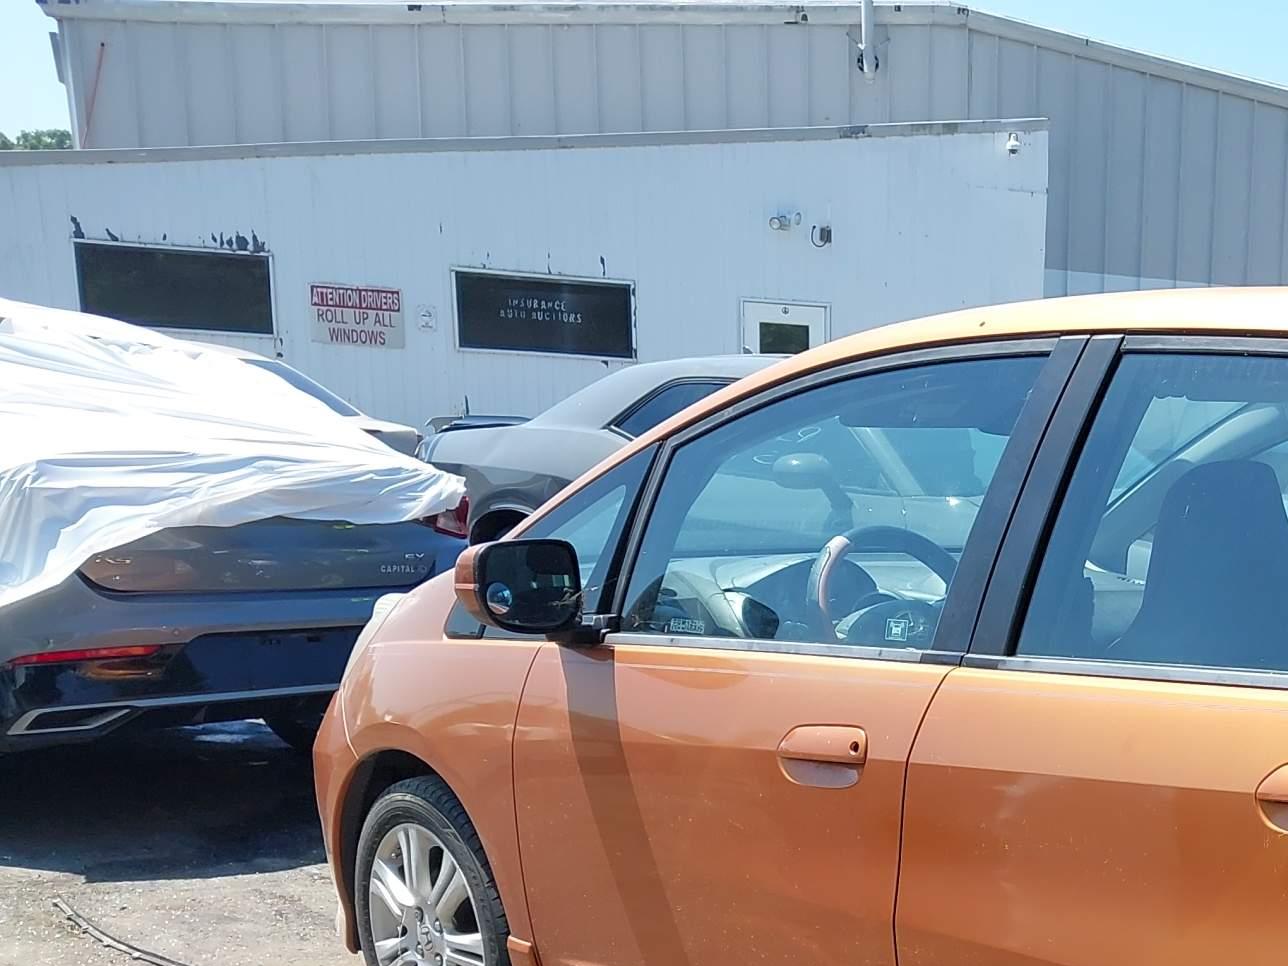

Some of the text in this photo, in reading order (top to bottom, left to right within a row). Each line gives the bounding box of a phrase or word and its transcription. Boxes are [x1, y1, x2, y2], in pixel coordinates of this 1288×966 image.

[312, 288, 399, 310] ATTENTION DRIVERS
[508, 298, 566, 311] INSURANCE
[317, 308, 396, 328] ROLL UP ALL
[328, 327, 386, 345] WINDOWS
[380, 565, 415, 573] CAPITAL
